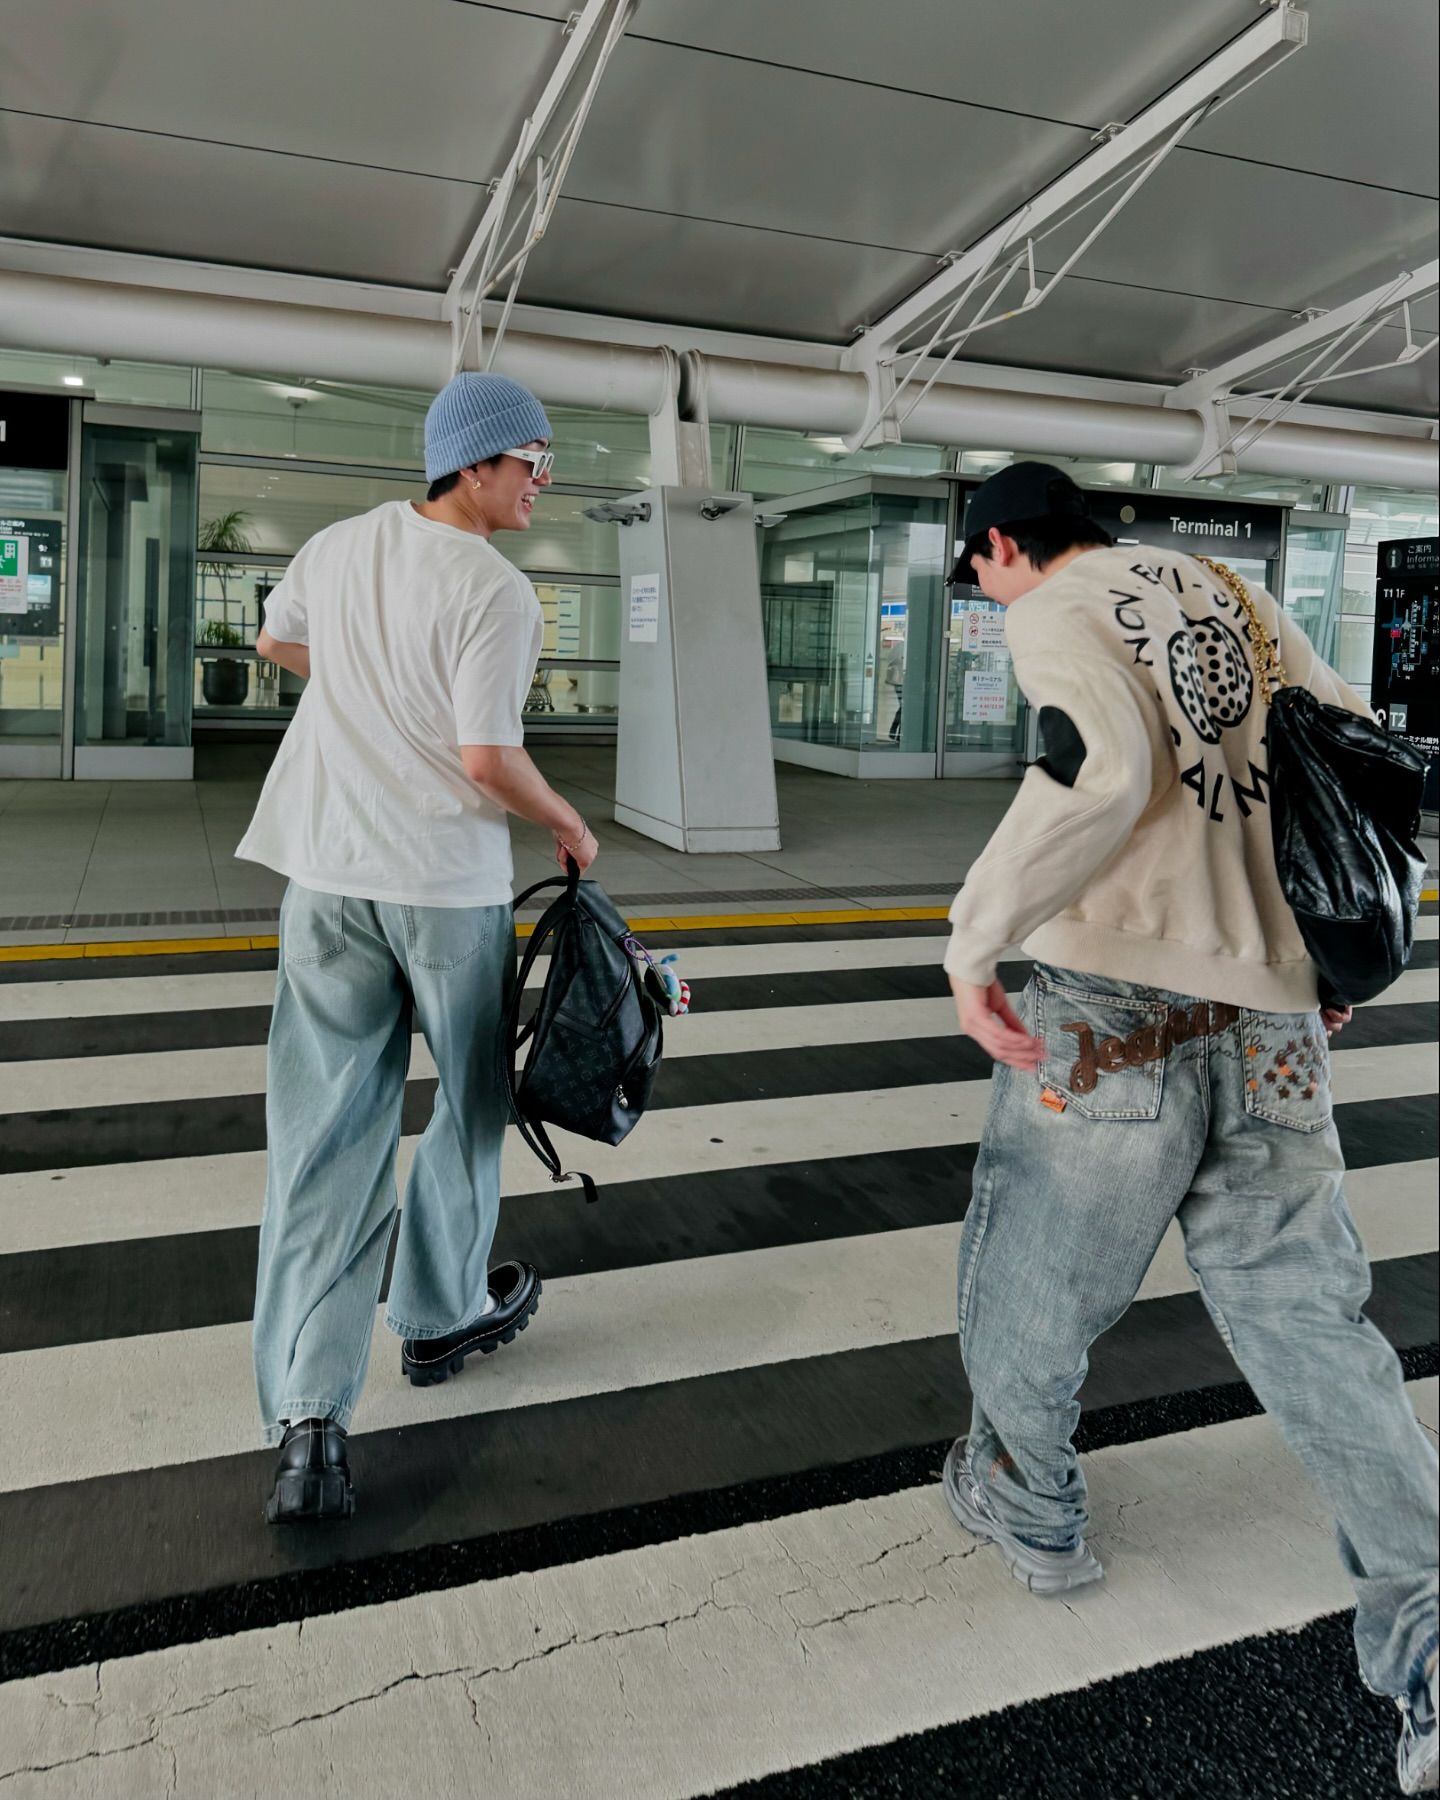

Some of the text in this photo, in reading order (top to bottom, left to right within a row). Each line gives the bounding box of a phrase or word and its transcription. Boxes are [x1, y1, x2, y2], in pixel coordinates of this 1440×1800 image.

[1170, 516, 1252, 539] Terminal 1
[1407, 544, 1432, 554] ご案内
[1389, 711, 1407, 728] T2
